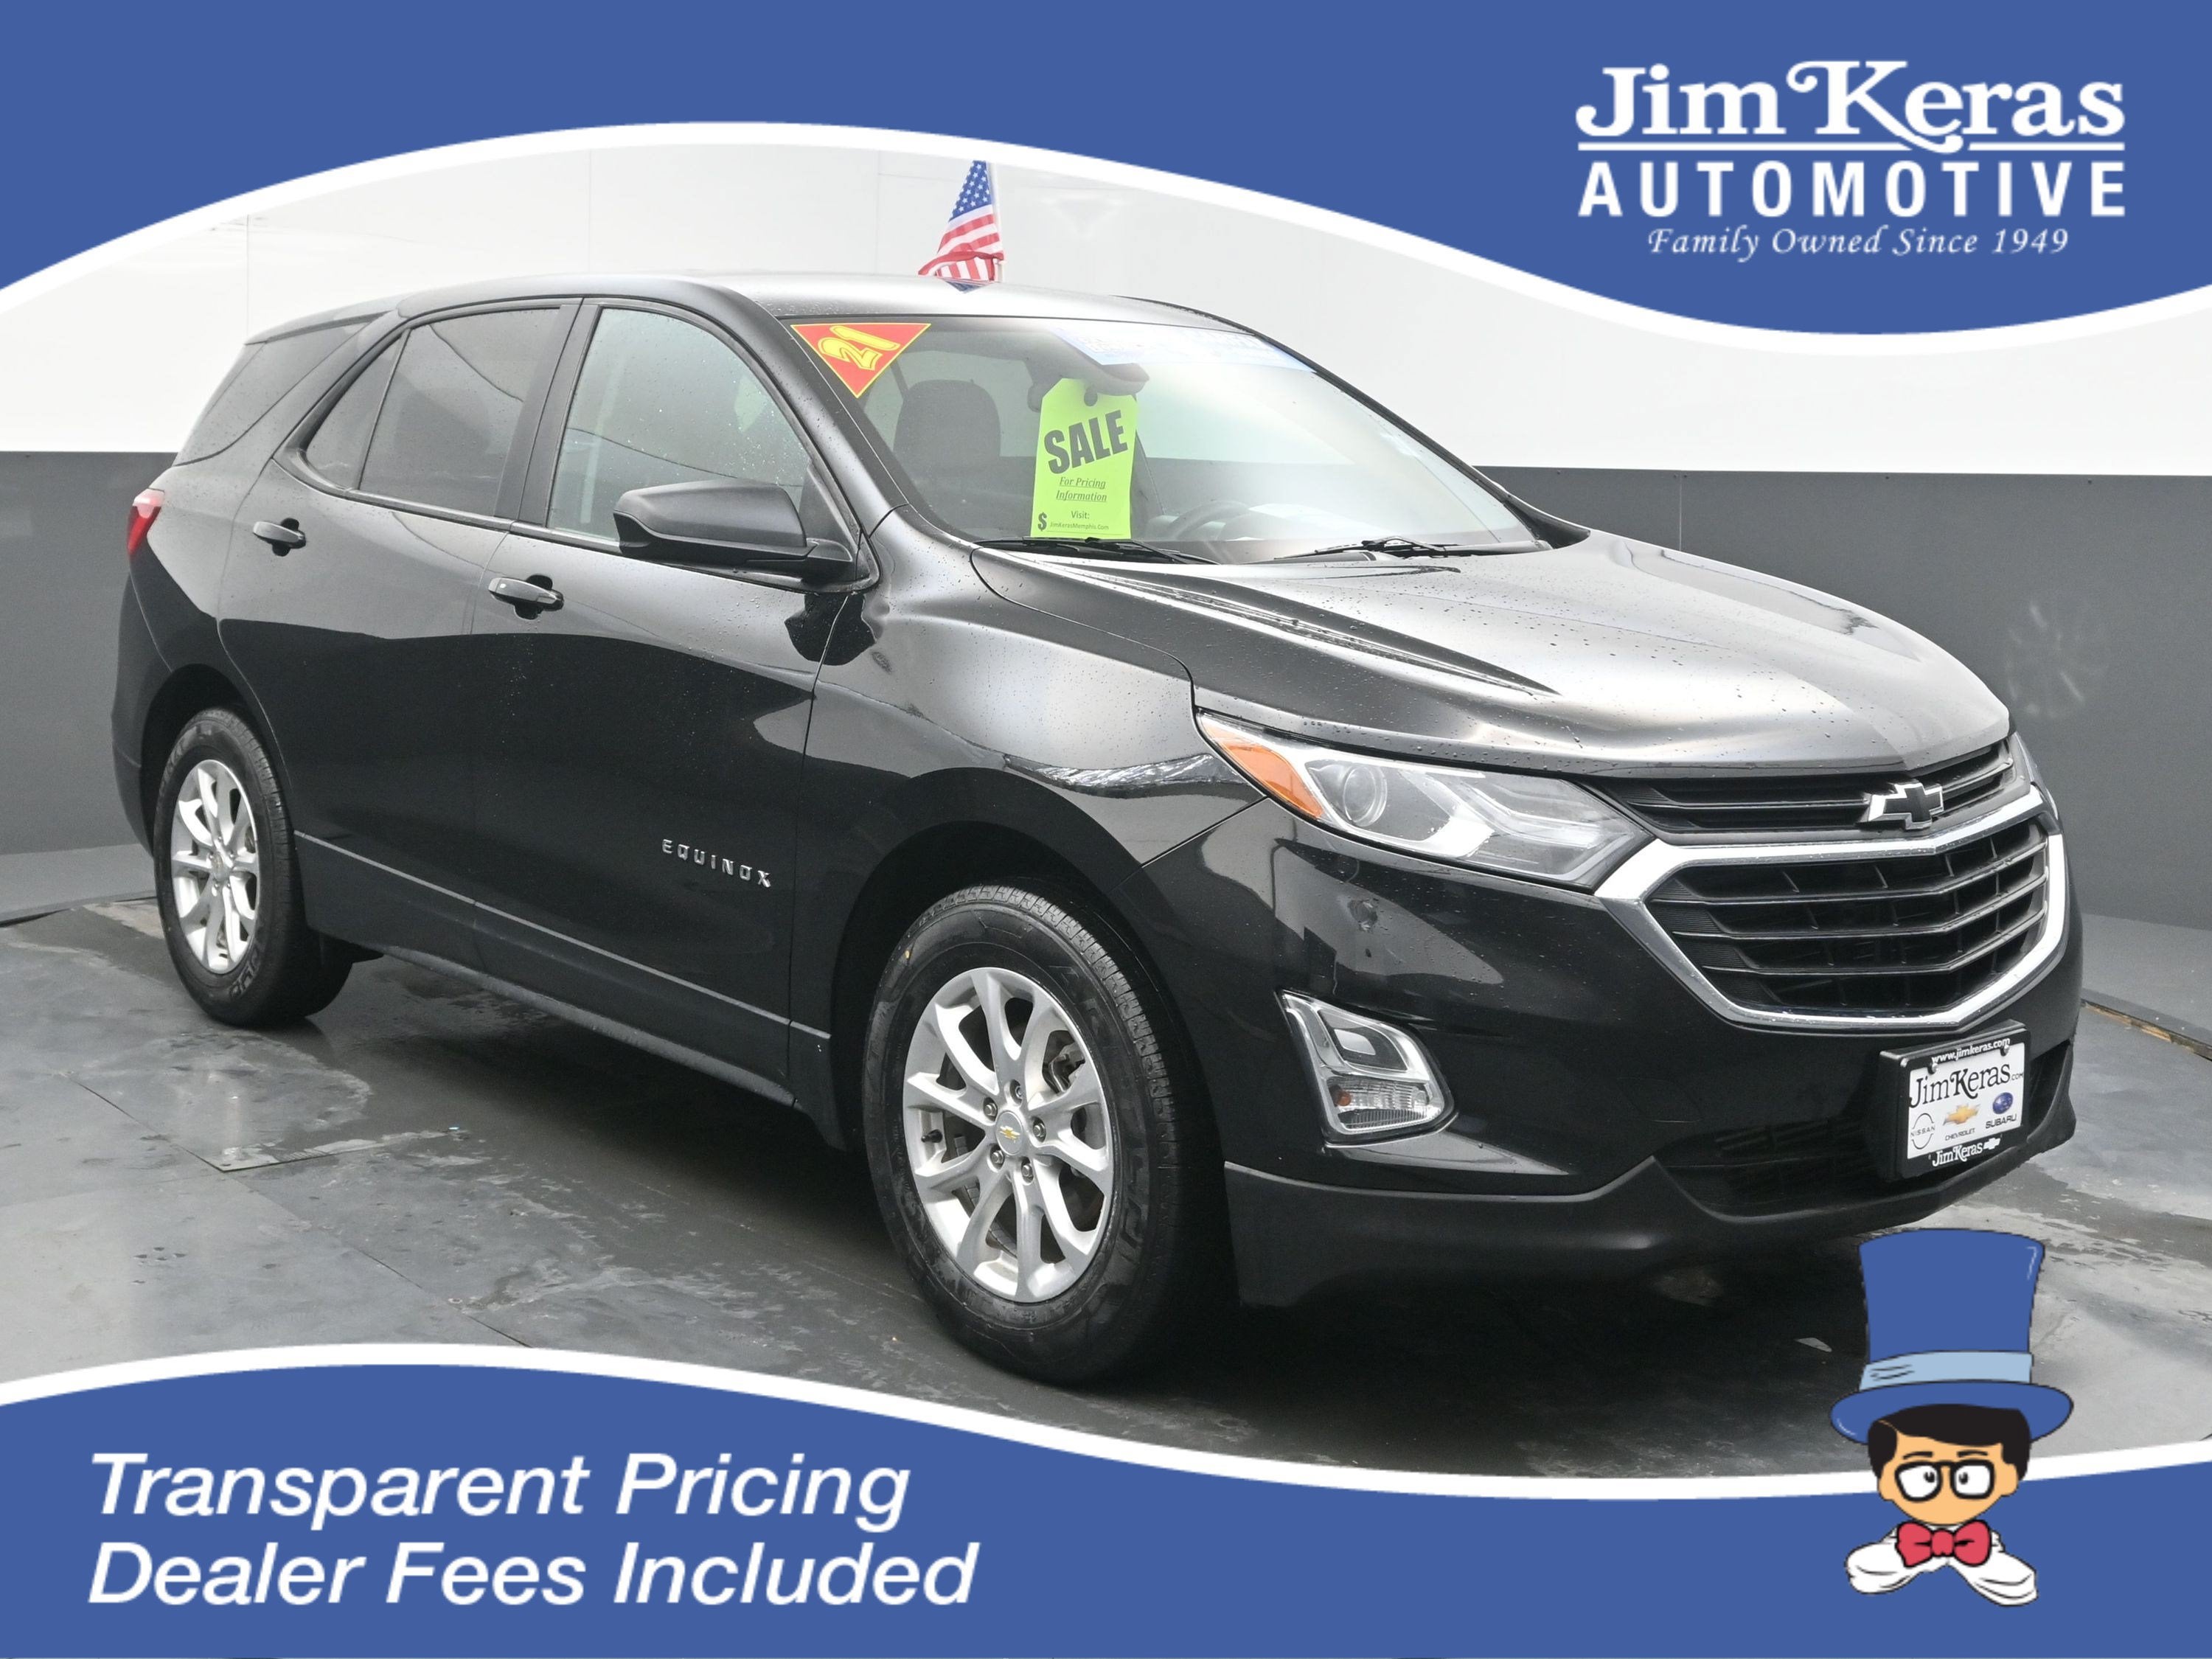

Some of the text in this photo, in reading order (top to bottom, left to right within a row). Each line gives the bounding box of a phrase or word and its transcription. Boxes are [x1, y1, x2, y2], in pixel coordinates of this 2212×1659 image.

[818, 325, 901, 371] 21
[1043, 409, 1129, 475] SALE
[1059, 476, 1107, 490] For Pricing
[1055, 490, 1107, 503] Information
[1037, 512, 1048, 531] $
[1071, 510, 1091, 520] Visit:
[661, 838, 772, 888] EQUINOX
[1931, 1037, 2011, 1062] www.jimkeras.com
[1985, 1113, 2017, 1129] SUBARU
[1910, 1126, 1935, 1138] NISSAN
[1944, 1128, 1976, 1141] CHEVROLET
